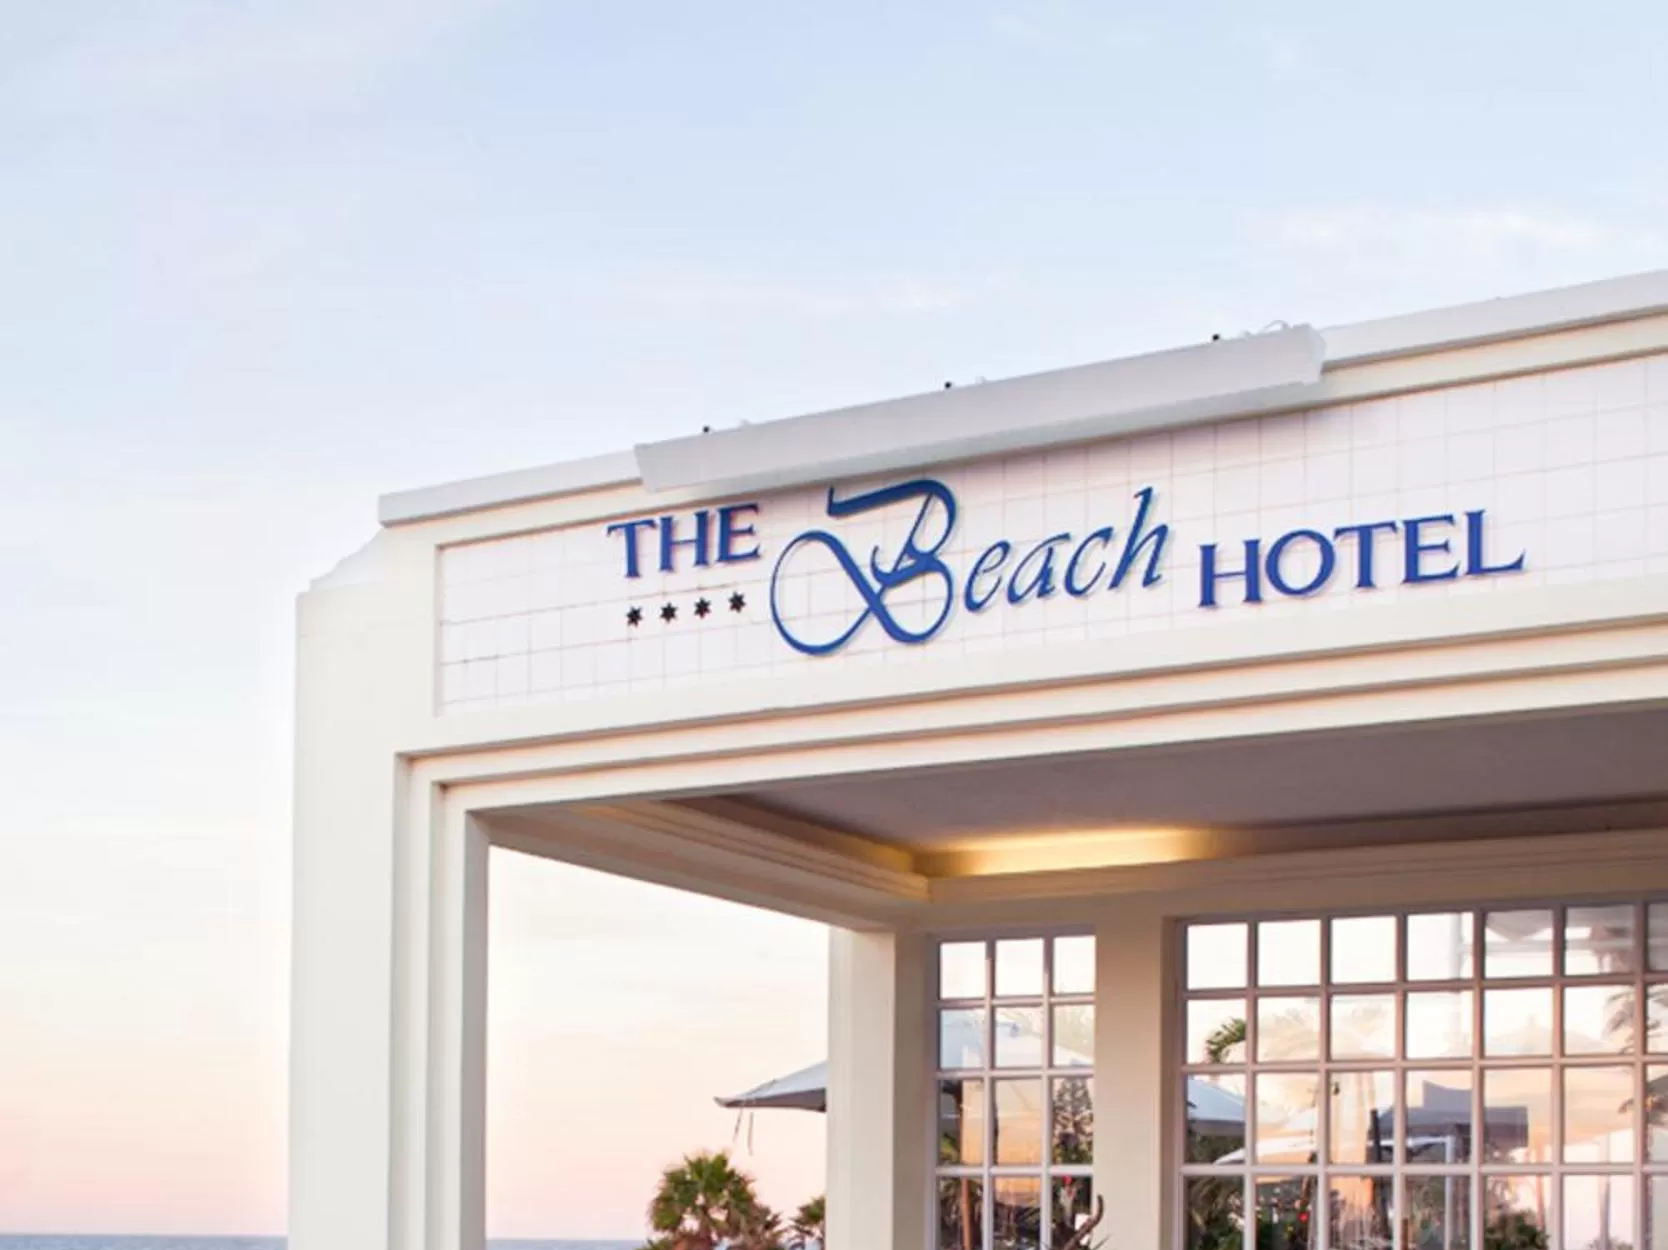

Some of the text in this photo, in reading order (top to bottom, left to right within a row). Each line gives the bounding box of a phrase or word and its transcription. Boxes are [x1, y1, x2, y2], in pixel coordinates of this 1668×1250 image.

[607, 478, 1525, 656] THE Beach HOTEL
